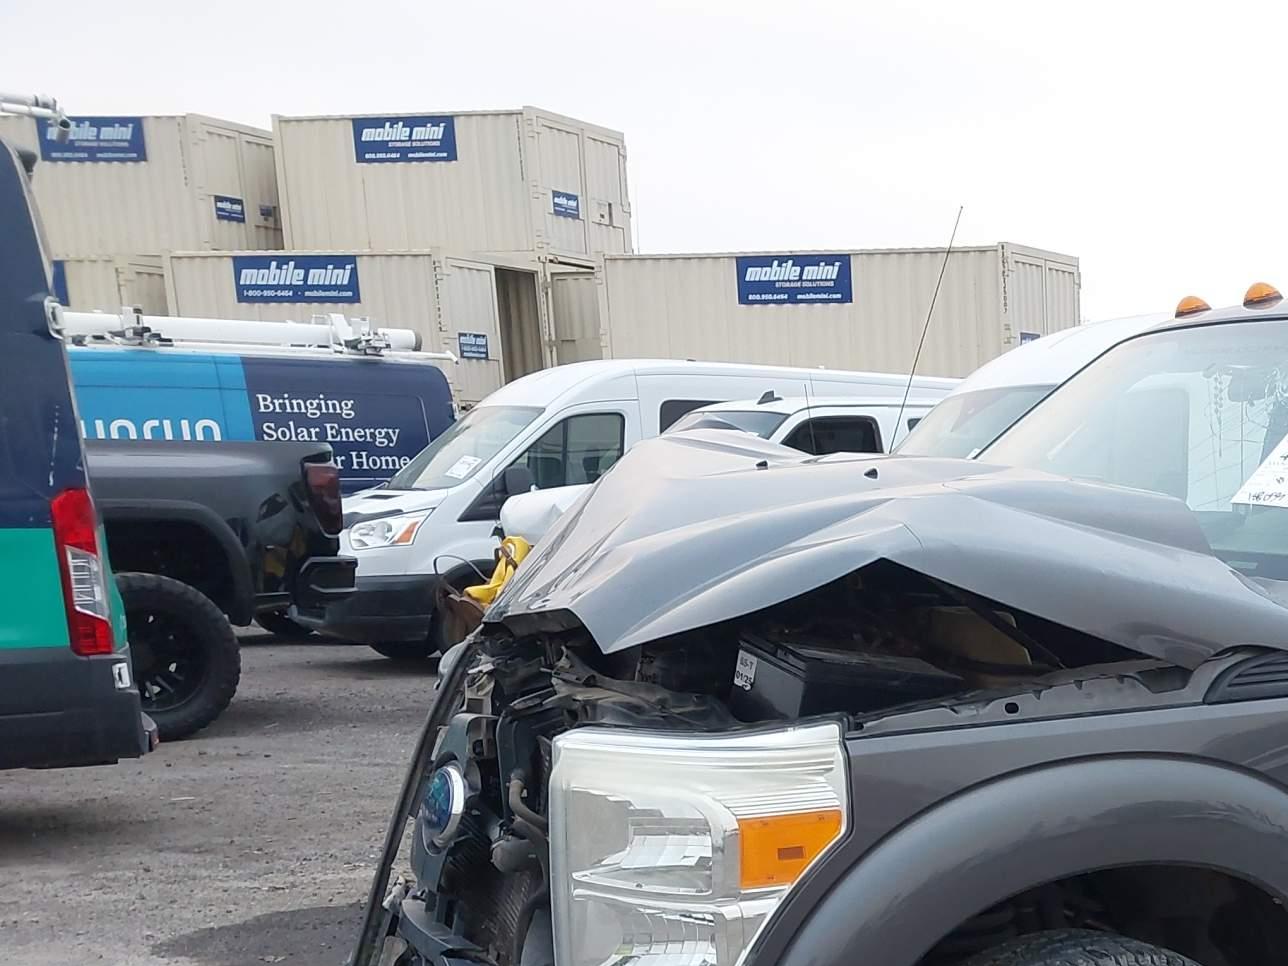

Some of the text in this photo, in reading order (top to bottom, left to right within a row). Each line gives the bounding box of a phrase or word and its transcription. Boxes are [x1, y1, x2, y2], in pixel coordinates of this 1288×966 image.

[46, 120, 133, 140] mbile mini
[361, 121, 446, 141] mobile mini
[240, 261, 352, 285] mobile mini
[745, 259, 841, 281] mobile mini
[255, 393, 355, 419] Bringing
[262, 421, 401, 447] Solar Energy
[349, 451, 411, 470] Home
